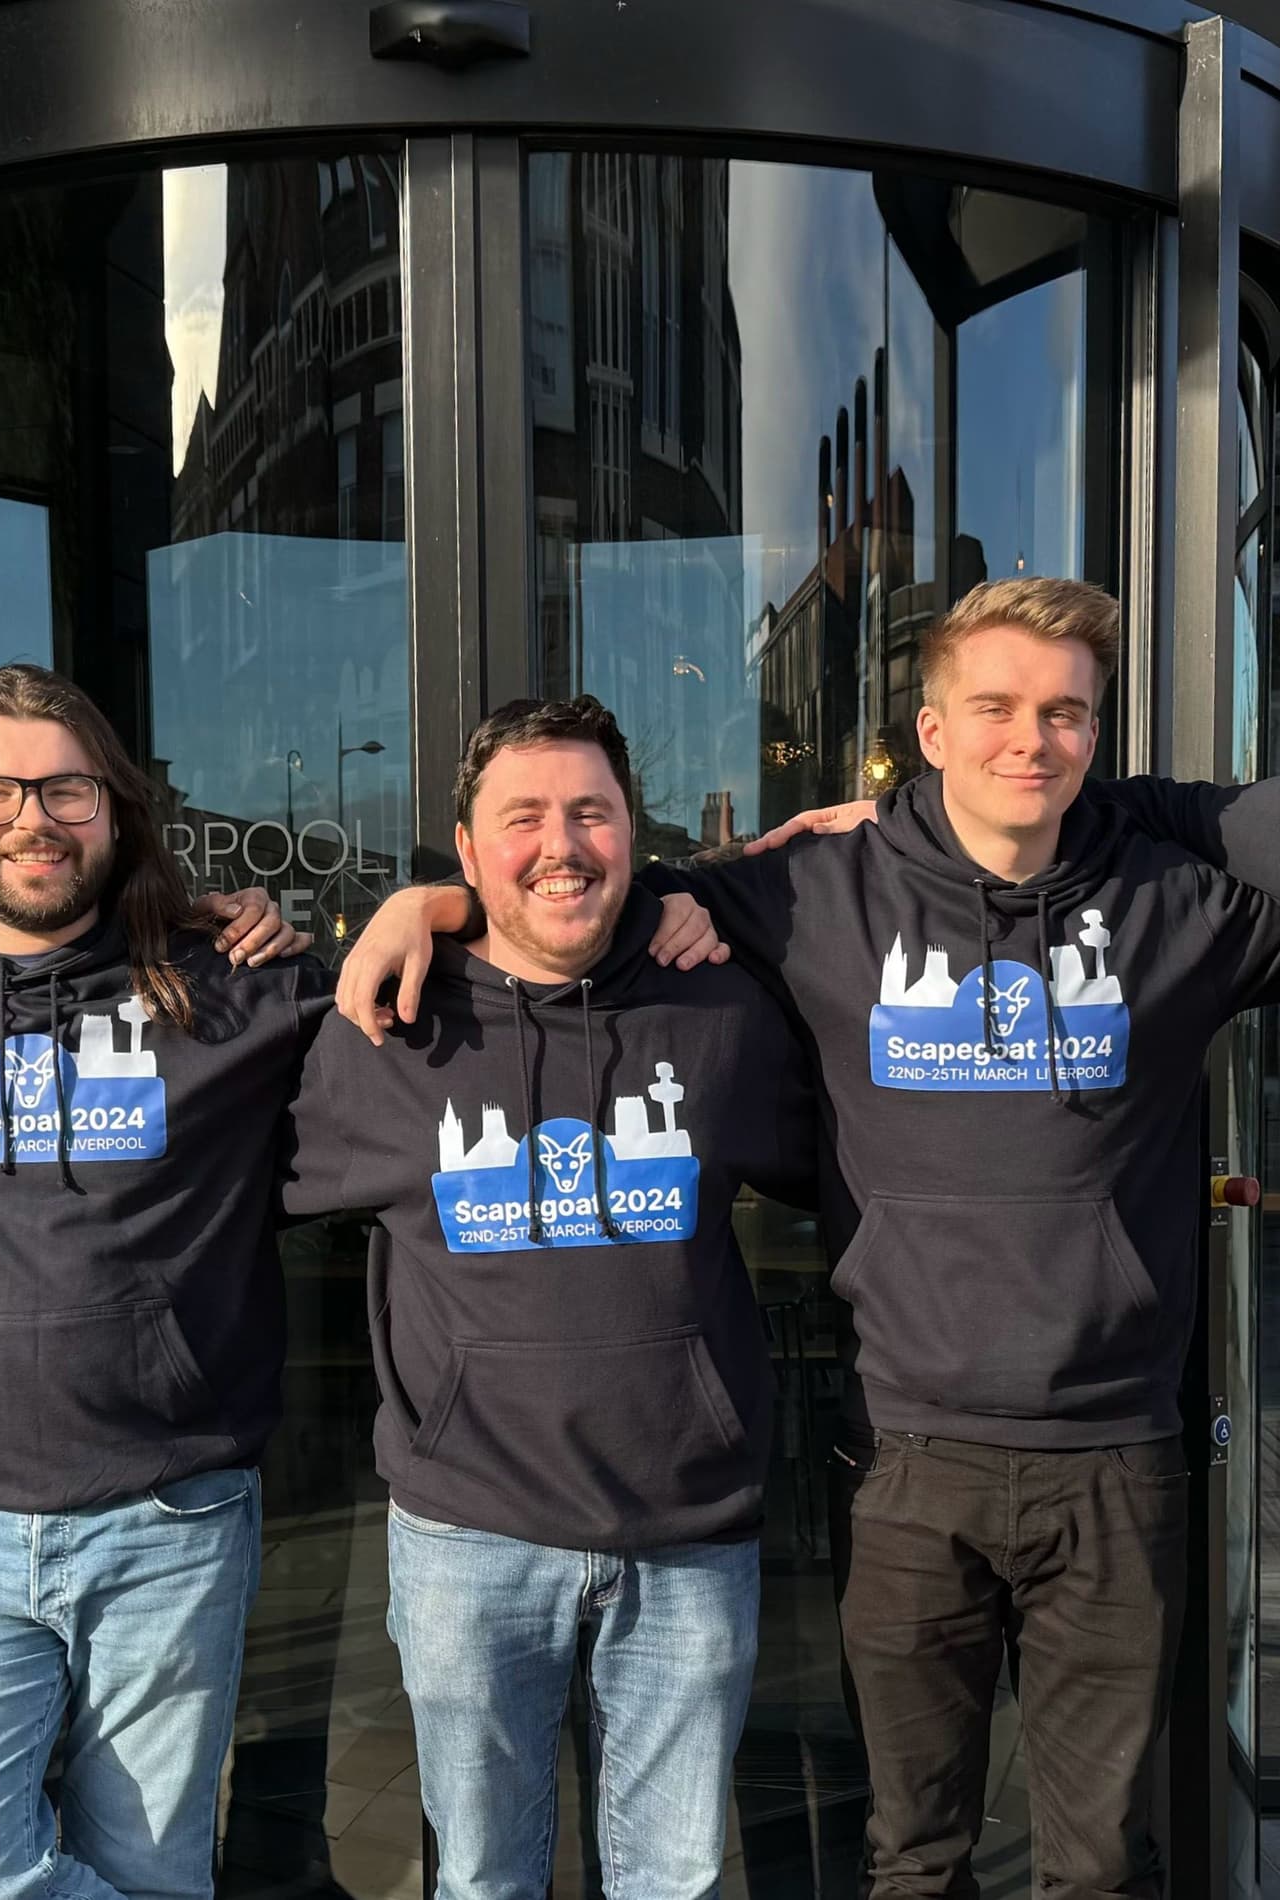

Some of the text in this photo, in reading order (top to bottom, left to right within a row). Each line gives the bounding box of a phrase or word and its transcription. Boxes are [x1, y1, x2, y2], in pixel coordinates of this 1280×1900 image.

[887, 1035, 1112, 1066] Scapegoat 2024
[887, 1066, 1110, 1080] 22ND-25TH MARCH LIERPOOL
[72, 1107, 146, 1131] 2024
[66, 1137, 146, 1151] LIVERPOOL
[455, 1187, 682, 1225] Scapegoat 2024
[458, 1218, 682, 1244] 22ND-25T MARCH VERPOOL
